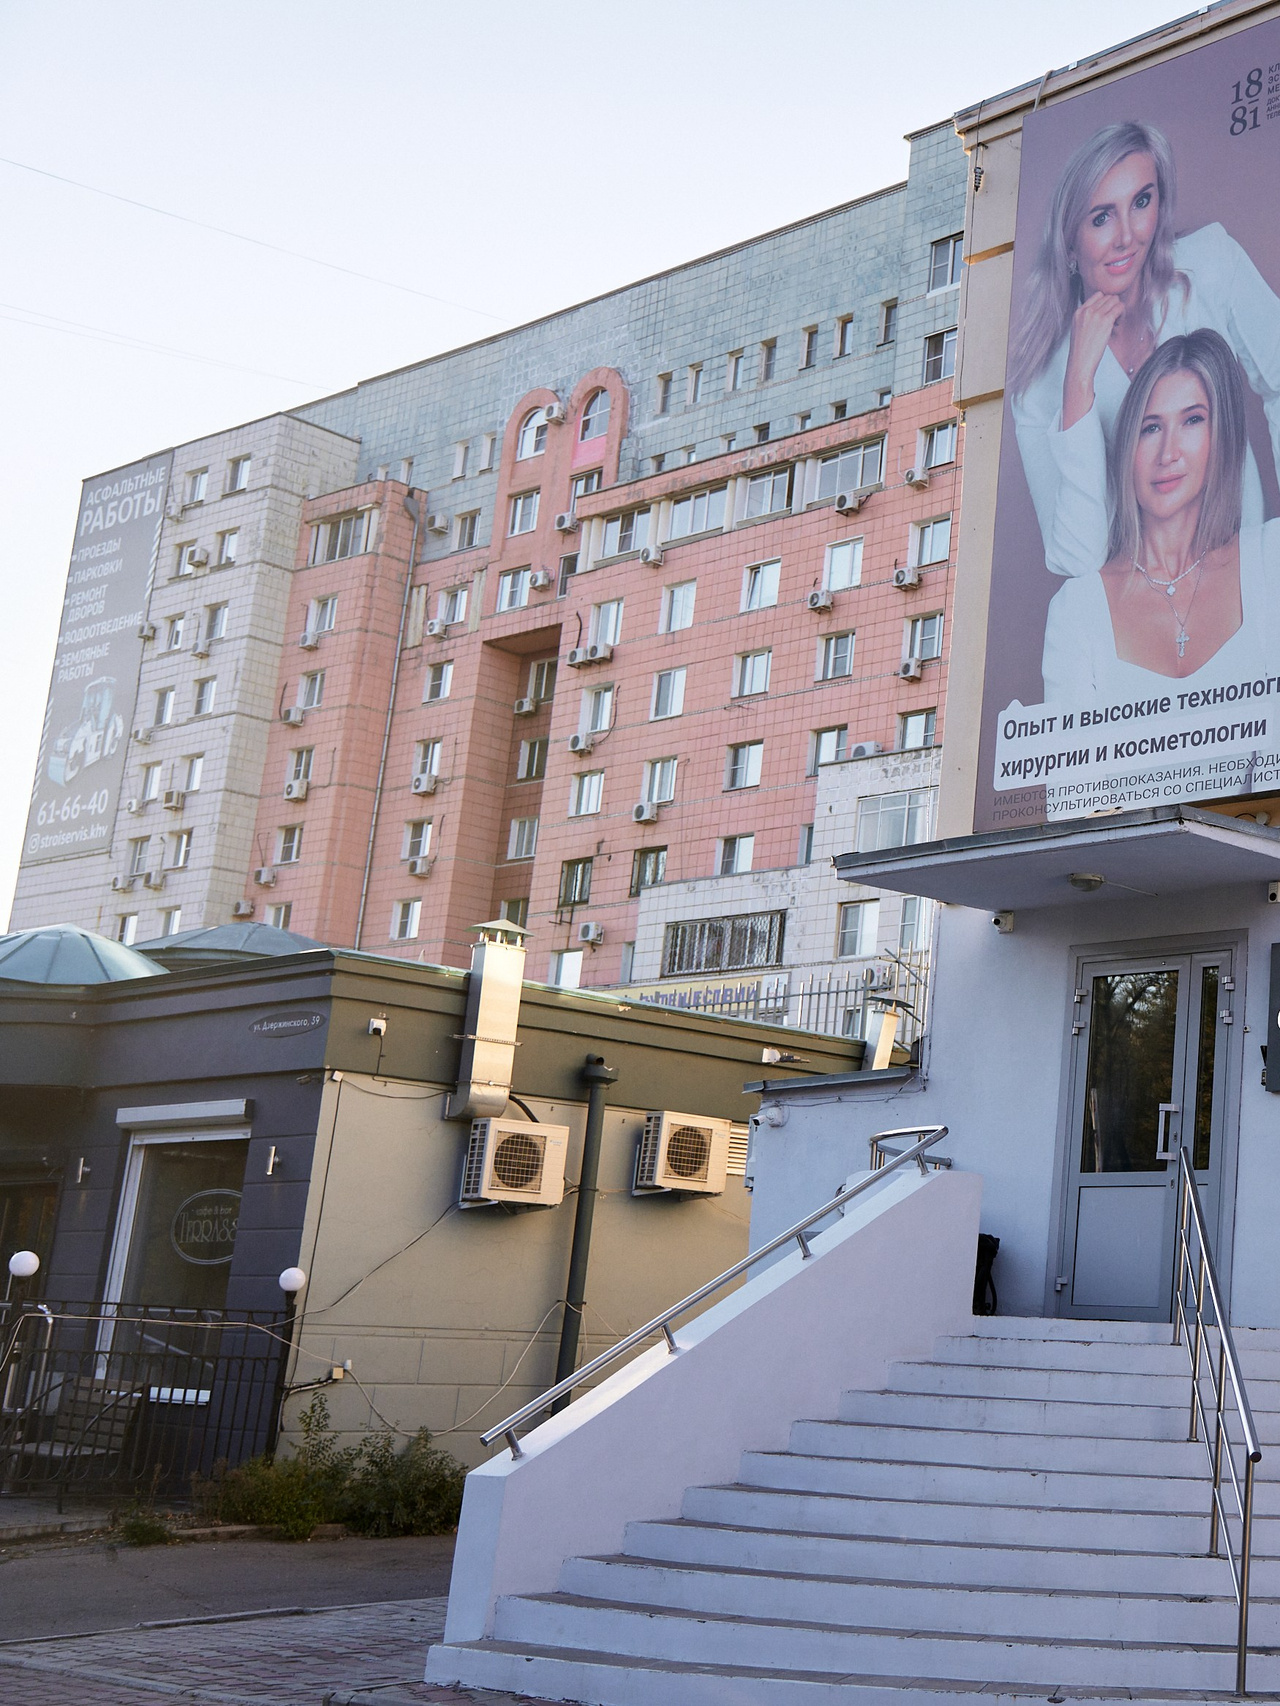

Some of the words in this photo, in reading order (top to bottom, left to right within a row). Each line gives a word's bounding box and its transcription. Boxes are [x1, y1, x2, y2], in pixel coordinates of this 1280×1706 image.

[1231, 68, 1263, 105] 18
[1229, 105, 1261, 136] 81
[85, 466, 167, 507] АСФАЛЬТНЫЕ
[80, 485, 163, 537] РАБОТЫ
[77, 537, 122, 562] ПРОЕЗДЫ
[73, 559, 123, 584] ПАРКОВКИ
[66, 600, 105, 625] ДВОРОВ
[70, 584, 109, 607] РЕМОНТ
[63, 611, 143, 645] ВОДООТВЕДЕНИЕ
[58, 661, 95, 683] РАБОТЫ
[60, 642, 111, 668] ЗЕМЛЯНЫЕ
[1003, 716, 1057, 740] Опыт
[1062, 714, 1074, 730] и
[1080, 696, 1171, 728] высокие
[1000, 748, 1089, 780] хирургии
[1095, 745, 1107, 762] и
[1113, 719, 1267, 760] косметологии
[992, 787, 1159, 822] ПРОКОНСУЛЬТИРОВАТЬСЯ
[1163, 783, 1182, 797] СО
[993, 788, 1055, 807] ИМЕЮТСЯ
[1058, 765, 1204, 797] ПРОТИВОПОКАЗАНИЯ.
[37, 788, 109, 826] 61-66-40
